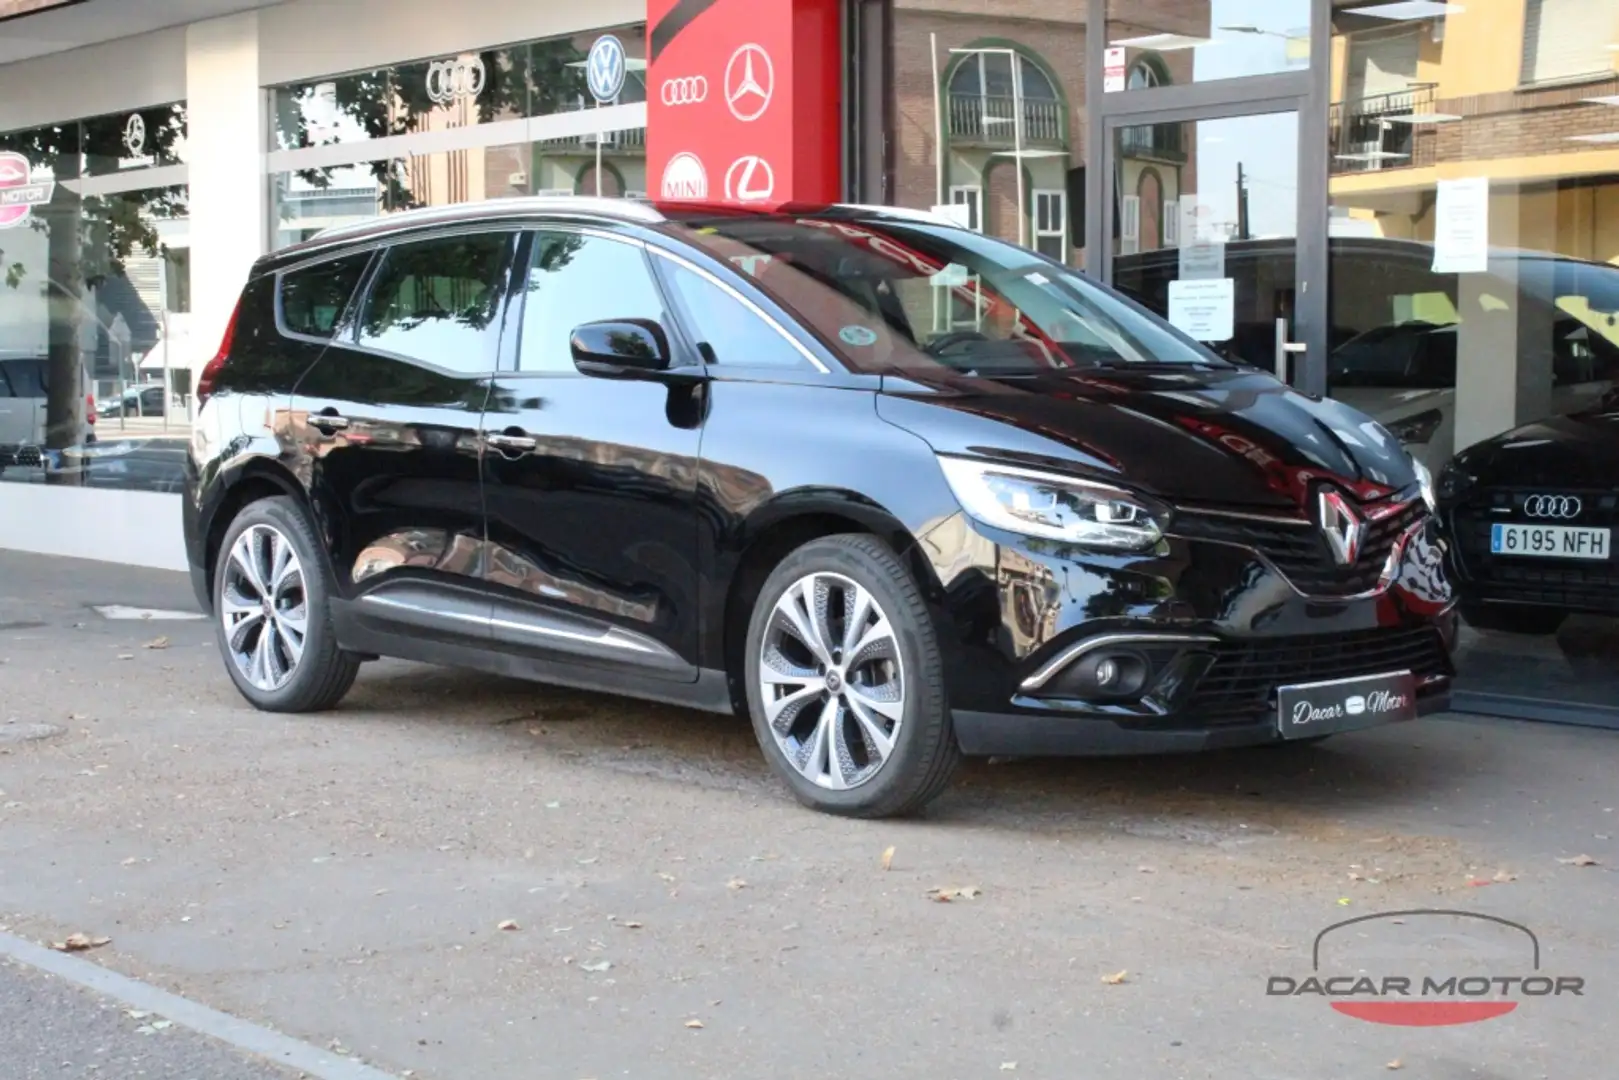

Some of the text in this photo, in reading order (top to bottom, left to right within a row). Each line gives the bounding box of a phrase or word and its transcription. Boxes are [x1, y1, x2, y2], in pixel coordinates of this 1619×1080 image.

[1, 187, 44, 203] MOTOR
[667, 179, 704, 198] MINI
[1506, 528, 1604, 555] 6195 NFH
[1291, 690, 1407, 724] Dacar Motor
